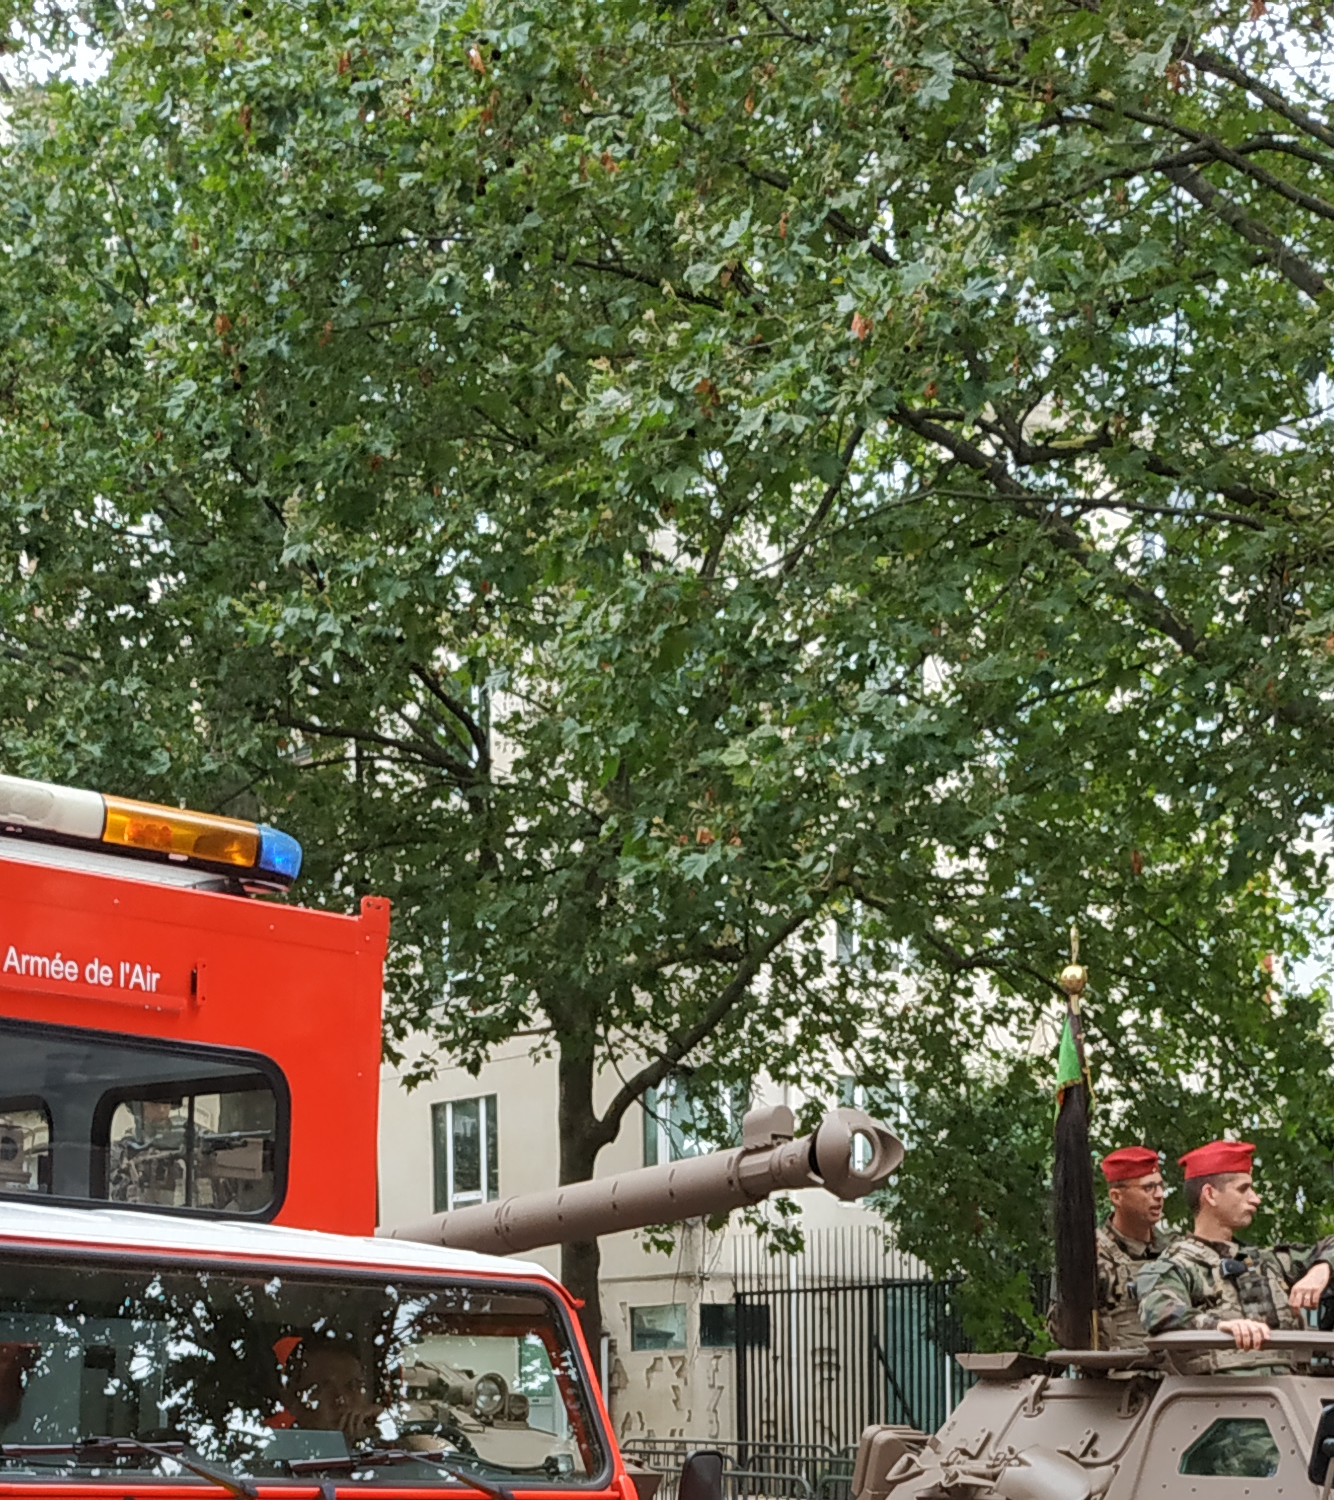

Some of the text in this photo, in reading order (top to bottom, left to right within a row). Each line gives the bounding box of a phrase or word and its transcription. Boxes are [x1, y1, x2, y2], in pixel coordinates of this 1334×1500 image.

[3, 946, 79, 982] Armée
[84, 957, 113, 987] de
[119, 960, 161, 993] l'Air
